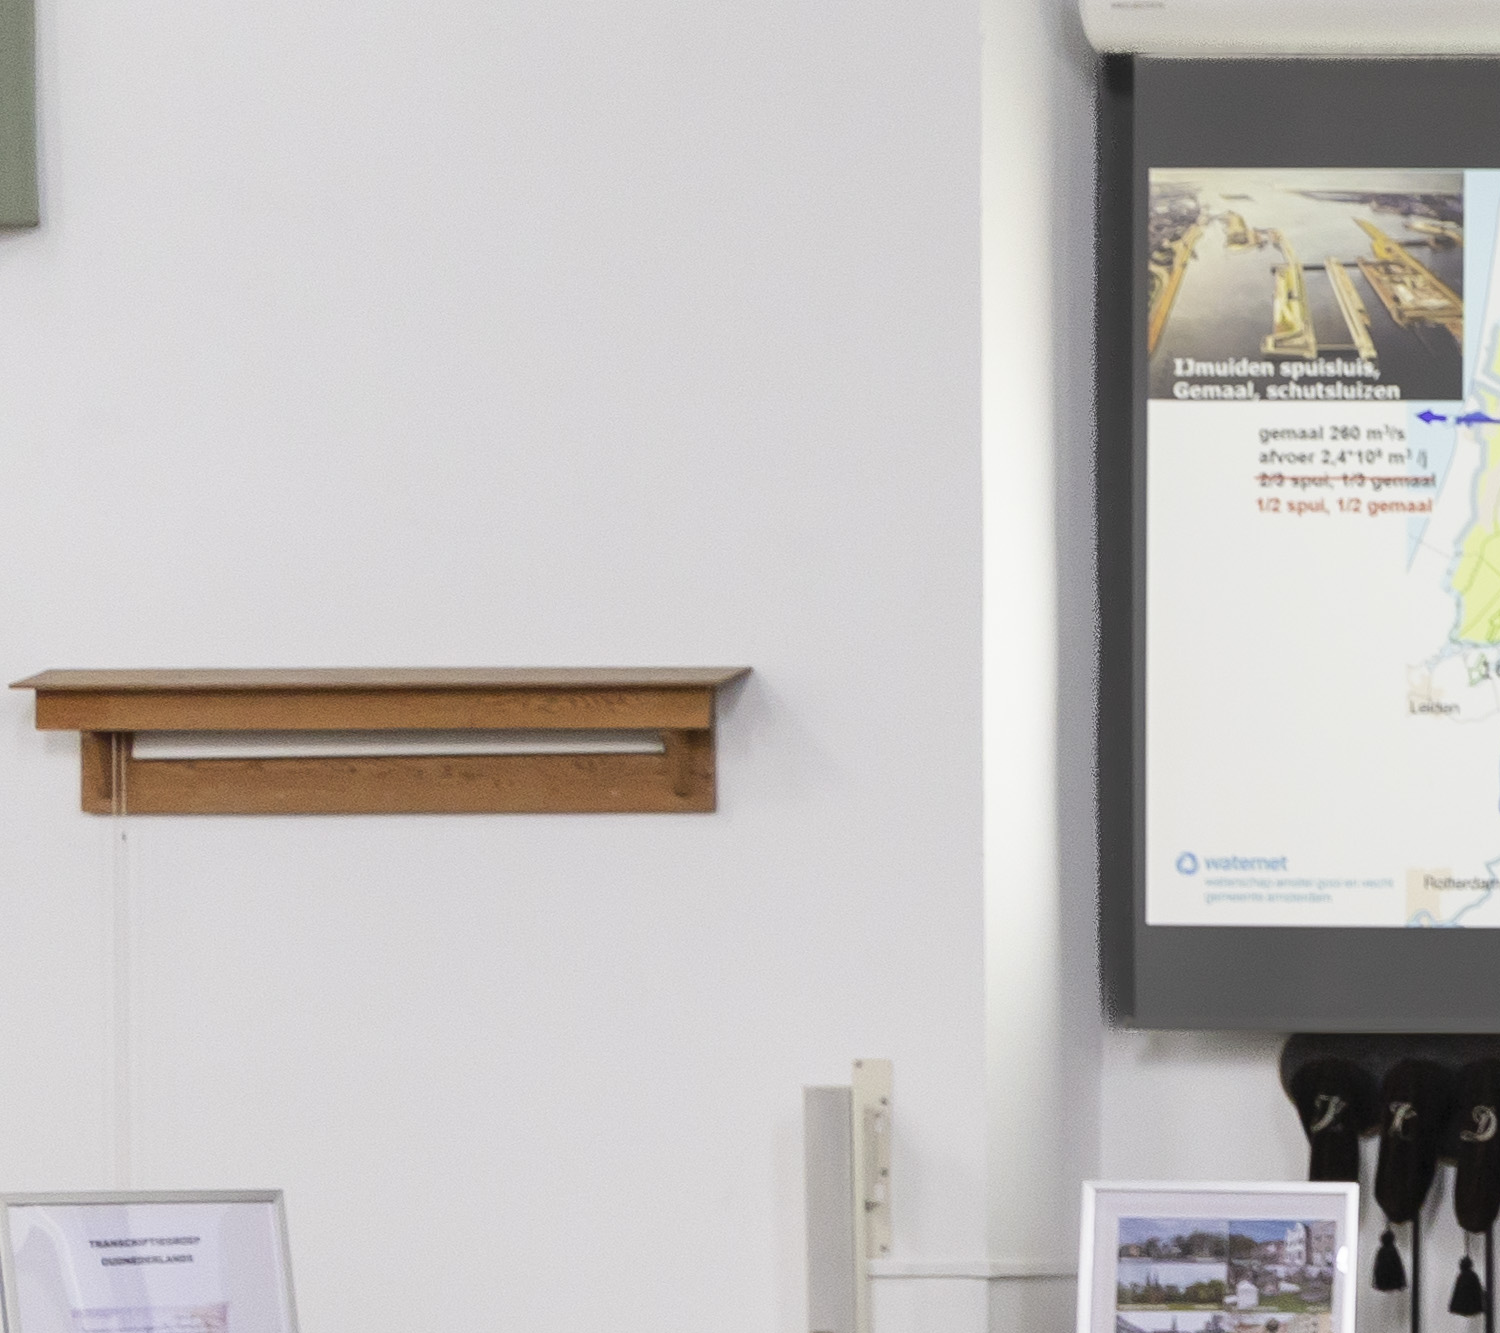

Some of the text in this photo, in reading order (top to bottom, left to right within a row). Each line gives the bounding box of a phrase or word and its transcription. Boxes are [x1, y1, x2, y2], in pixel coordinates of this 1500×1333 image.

[1173, 358, 1275, 378] IJmuiden
[1173, 381, 1401, 401] Gemaal, schutsluizen
[1258, 426, 1325, 445] gemaal
[1258, 450, 1315, 465] afvoer
[1372, 474, 1437, 492] gemaal
[1256, 497, 1282, 514] 1/2
[1338, 498, 1363, 514] 1/2
[1368, 498, 1434, 518] gemaal
[1204, 855, 1288, 872] waternet
